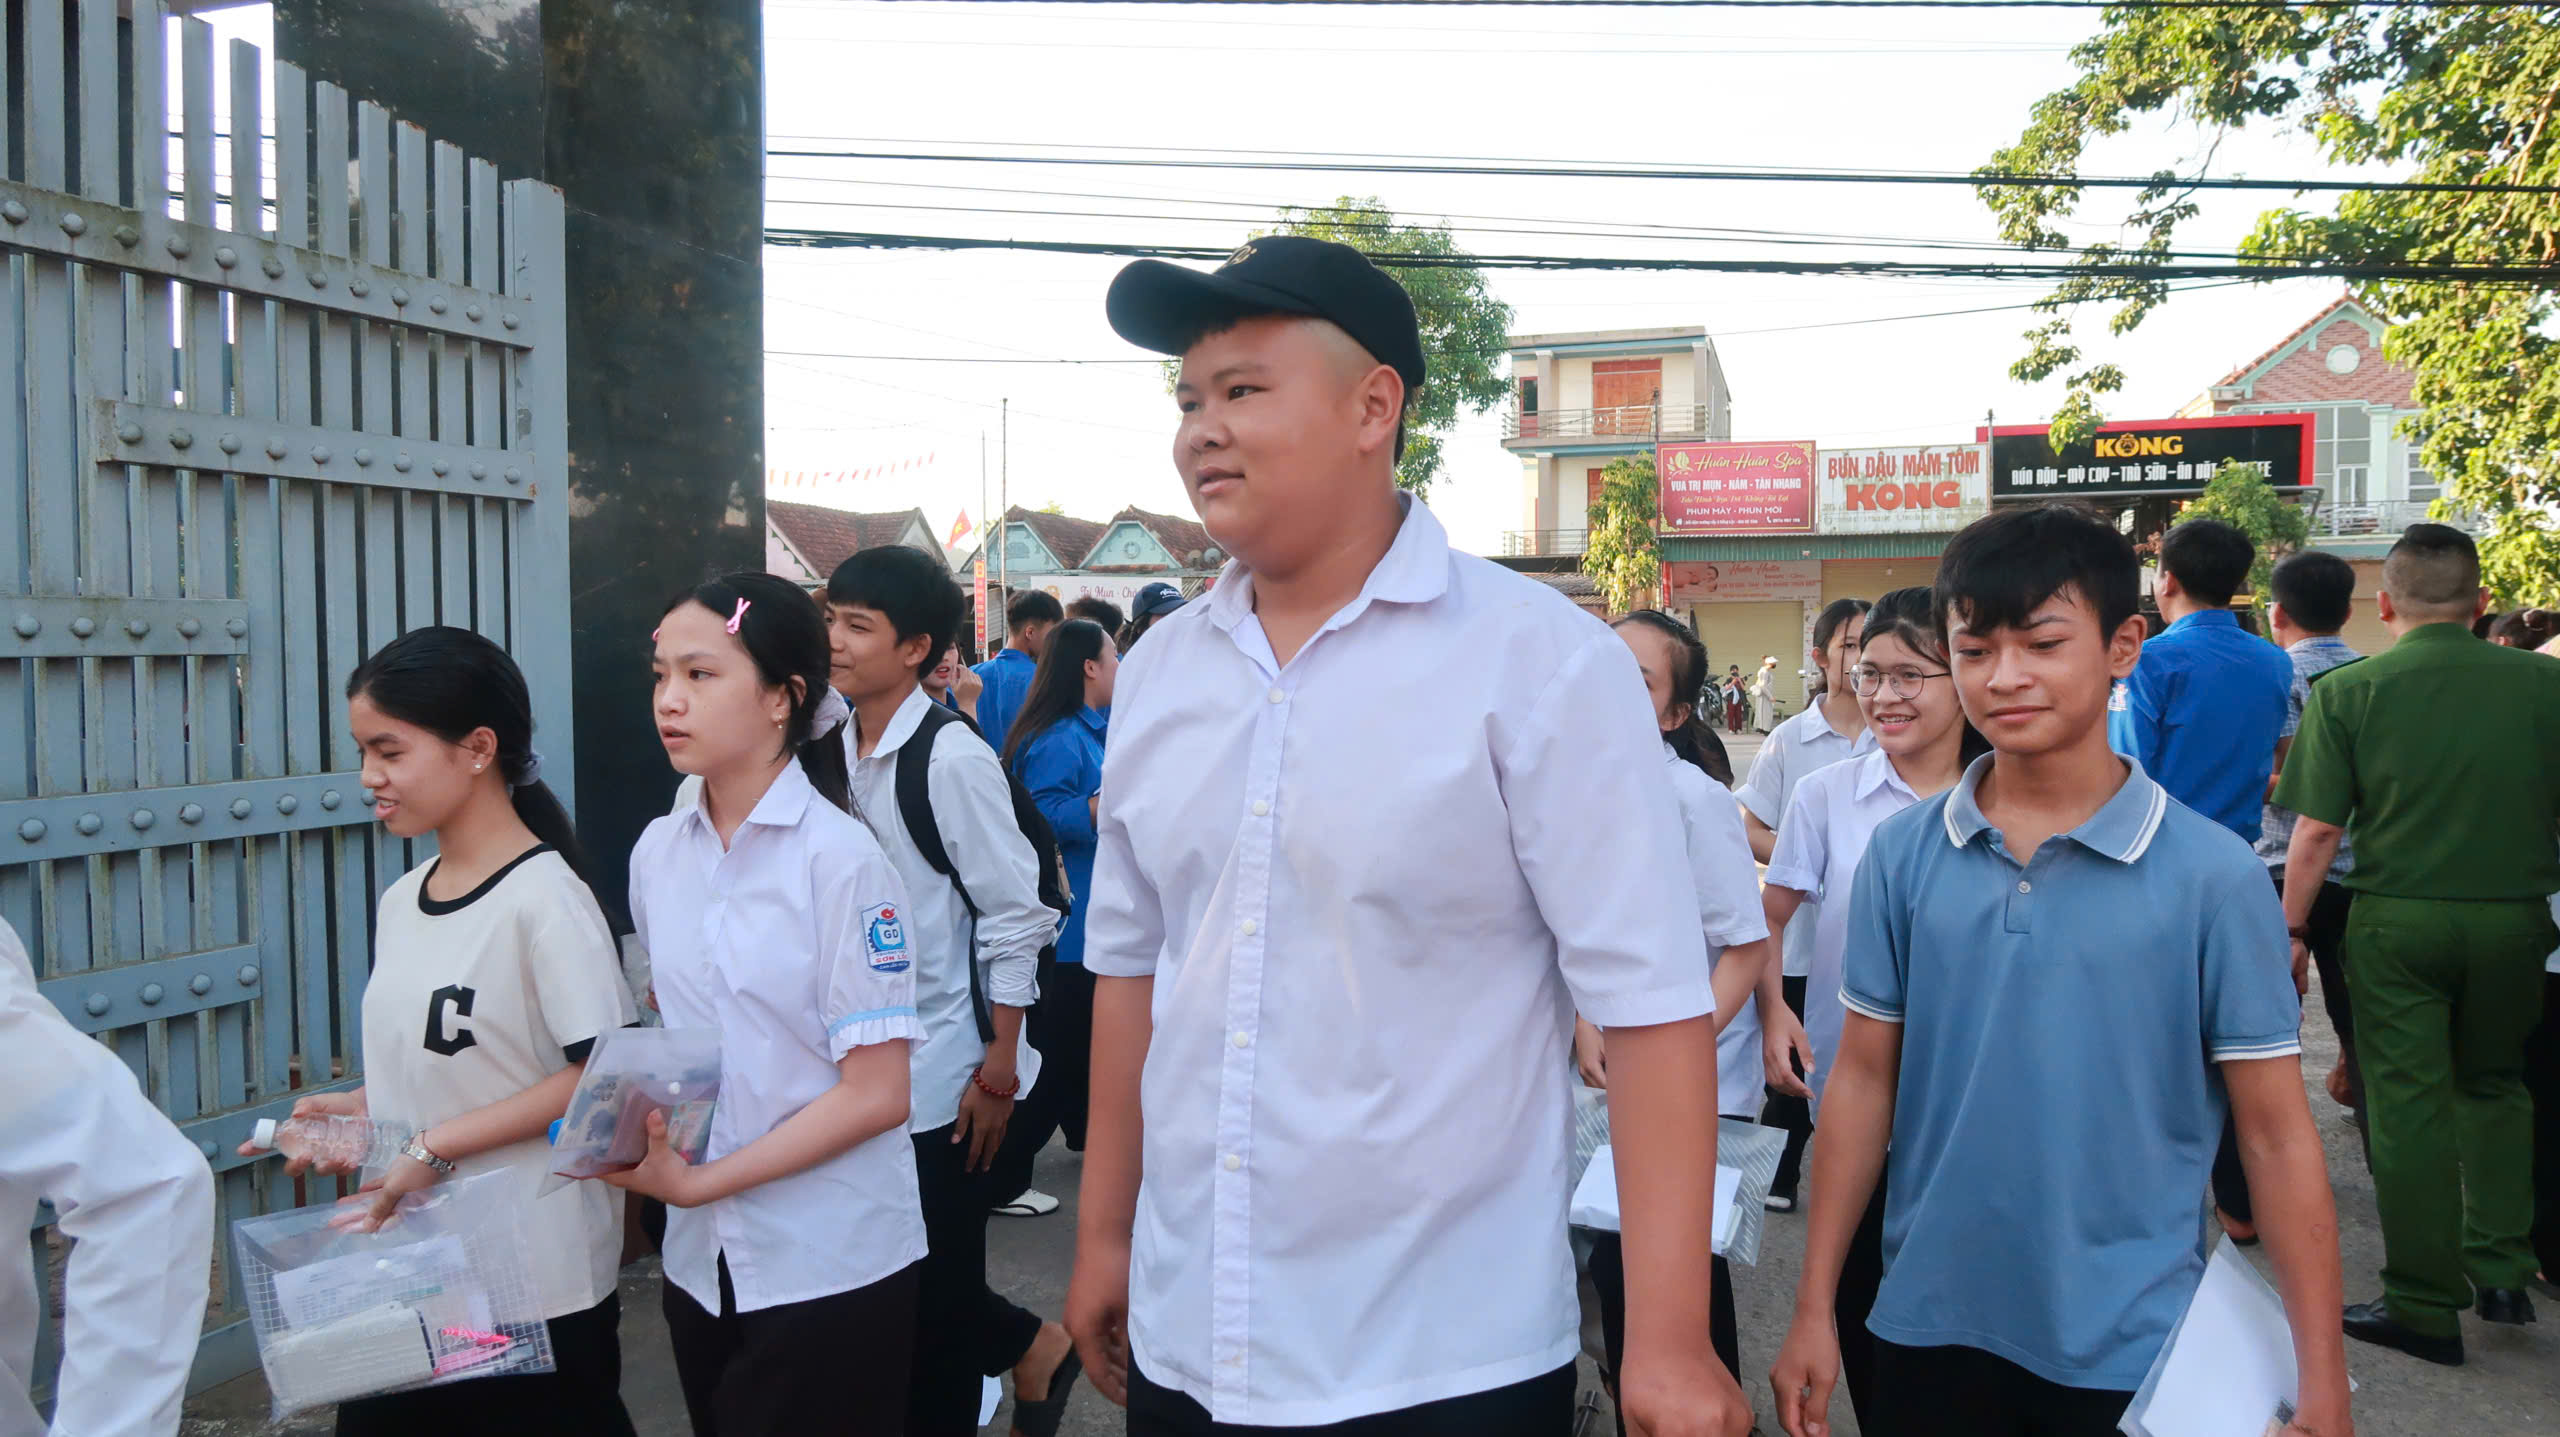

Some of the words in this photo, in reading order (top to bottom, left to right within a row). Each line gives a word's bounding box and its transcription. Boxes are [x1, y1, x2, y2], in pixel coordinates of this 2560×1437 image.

[1773, 451, 1803, 472] Spa
[1828, 452, 1859, 479] BÚN
[1865, 451, 1896, 481] ĐẬU
[1903, 447, 1941, 475] MẮM
[1947, 447, 1980, 474] TÔM
[1671, 480, 1687, 492] VUA
[1772, 478, 1802, 489] NHANG
[1686, 507, 1710, 515] PHUN
[1738, 507, 1763, 515] PHUN
[423, 984, 477, 1056] C
